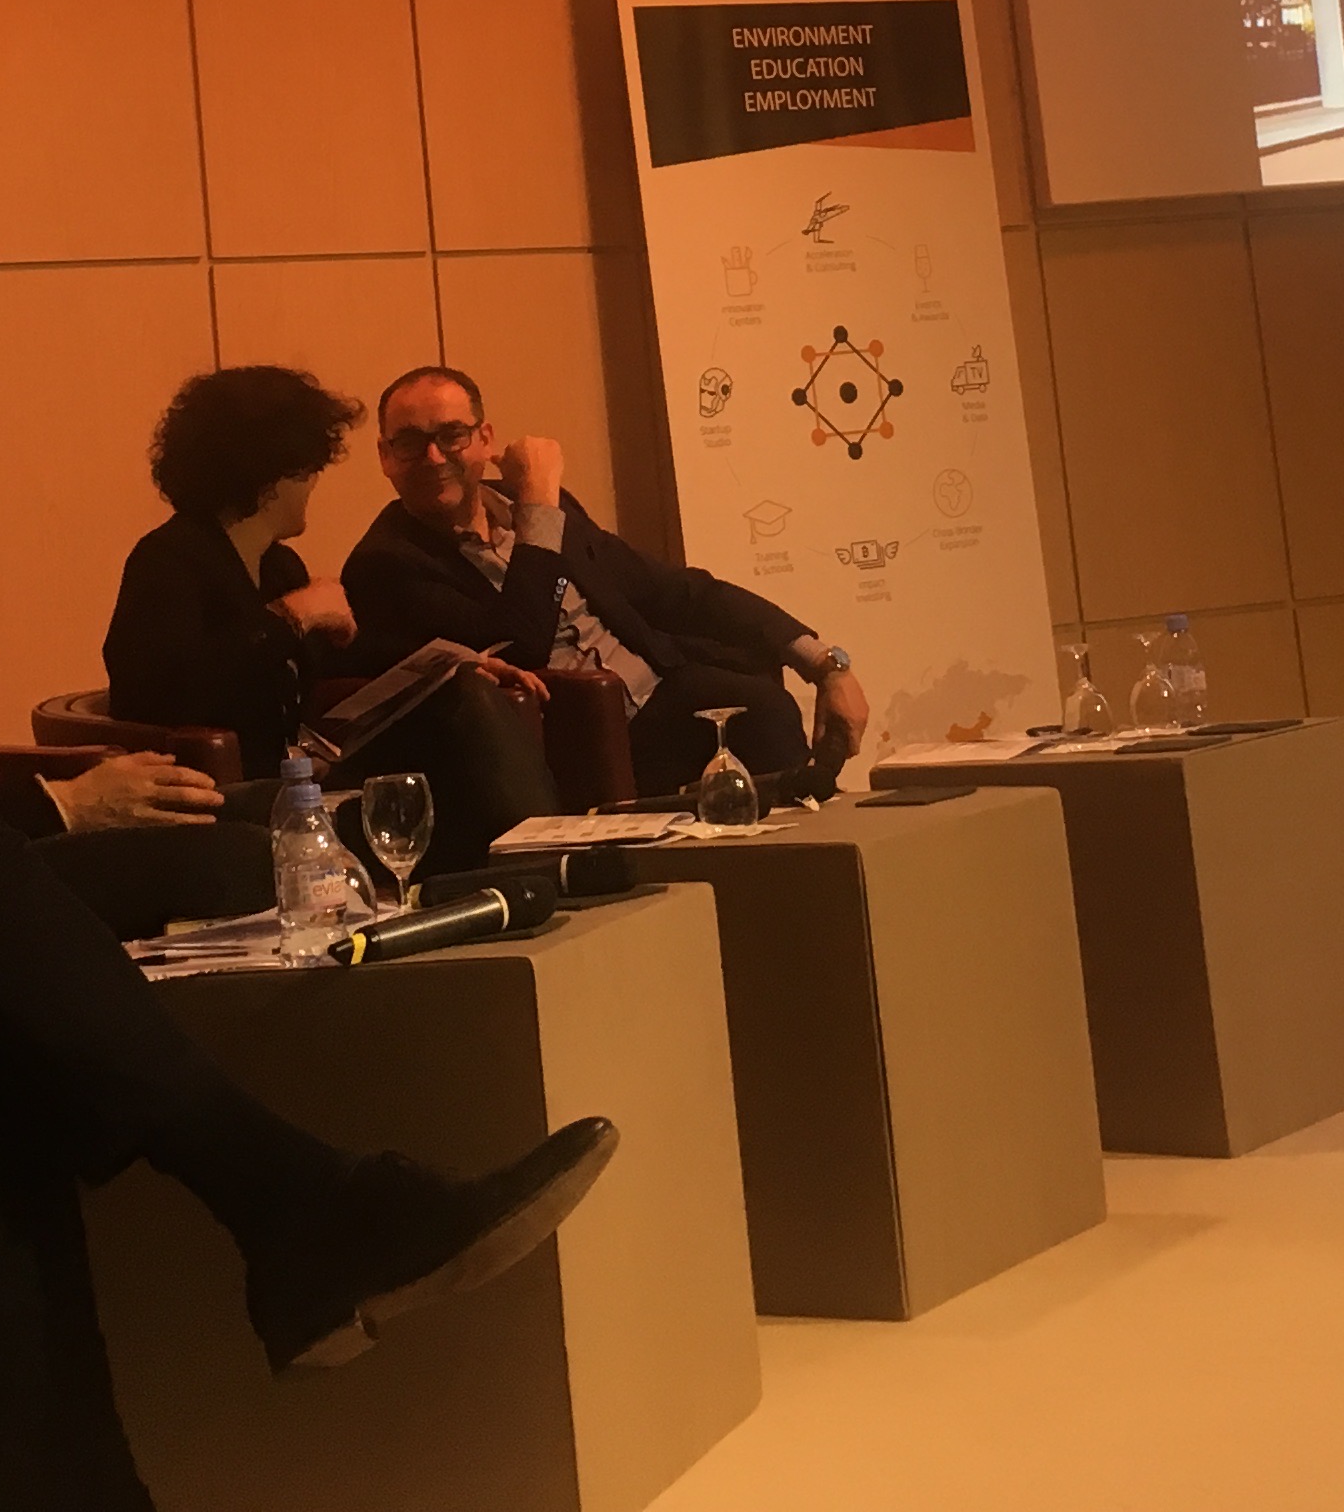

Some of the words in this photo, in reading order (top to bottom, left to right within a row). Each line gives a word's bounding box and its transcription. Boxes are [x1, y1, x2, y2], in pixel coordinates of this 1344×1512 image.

[732, 25, 874, 48] ENVIRONMENT
[750, 56, 864, 80] EDUCATION
[744, 88, 877, 112] EMPLOYMENT
[970, 366, 984, 379] TV
